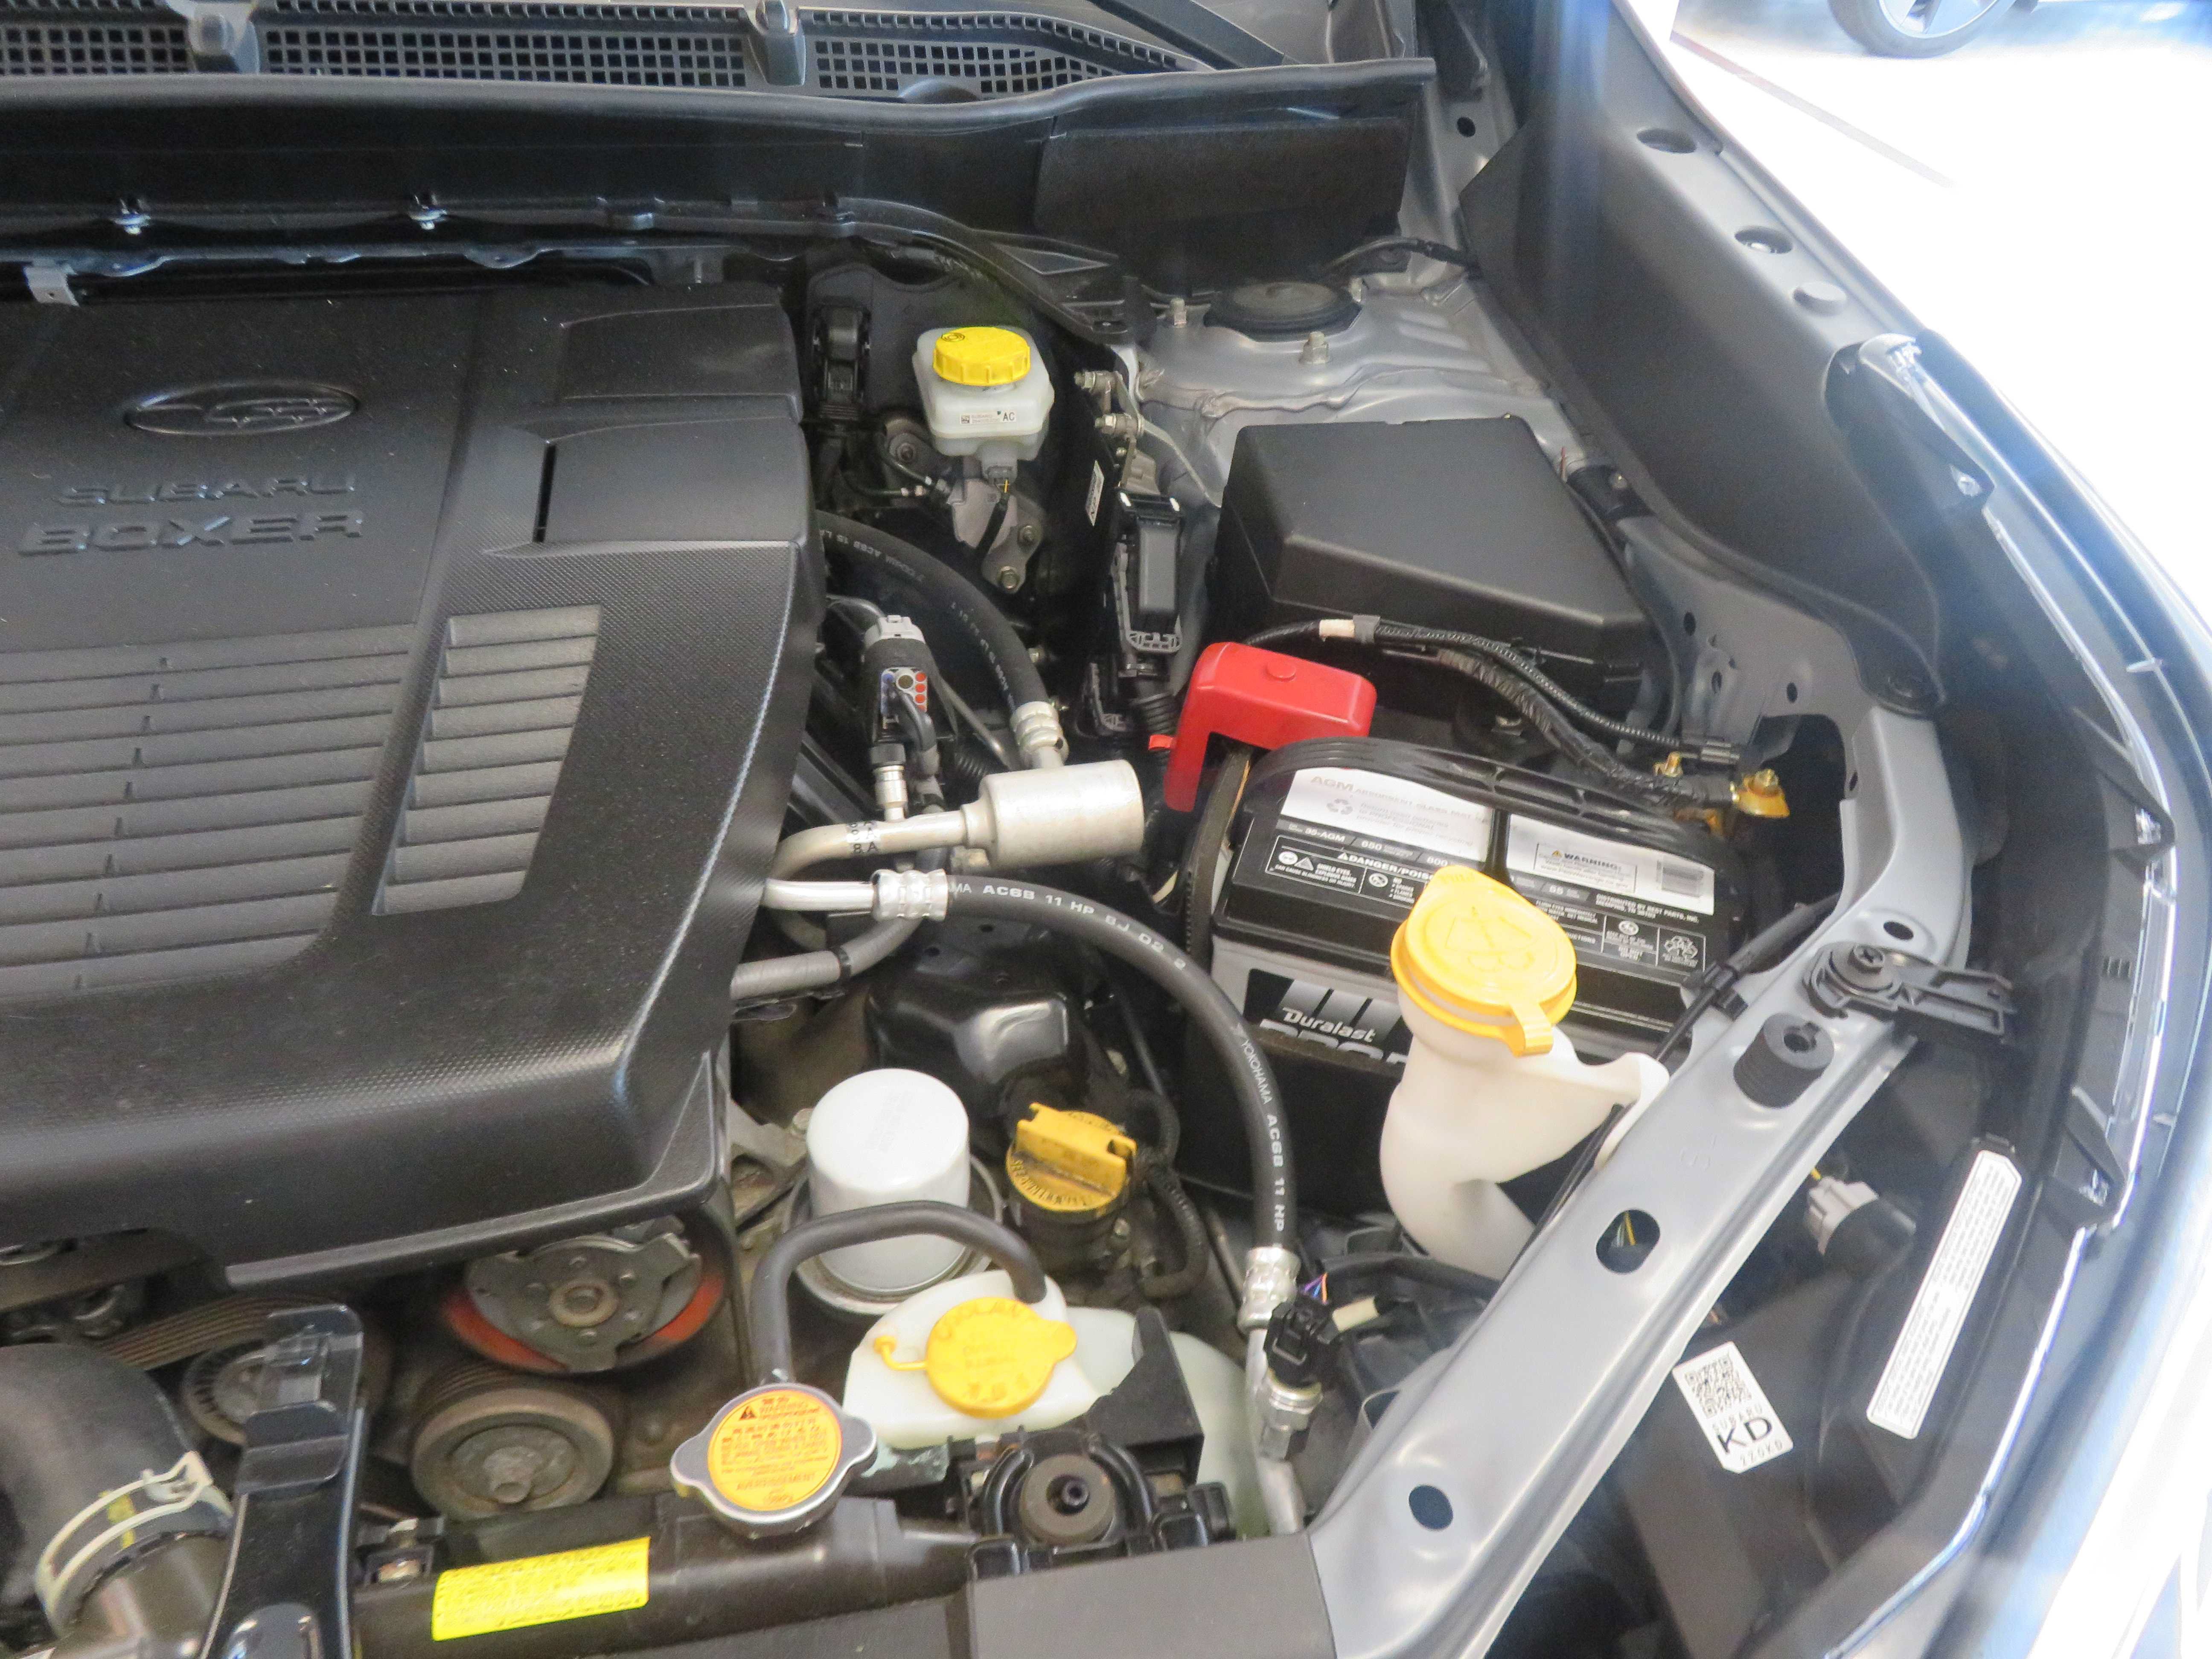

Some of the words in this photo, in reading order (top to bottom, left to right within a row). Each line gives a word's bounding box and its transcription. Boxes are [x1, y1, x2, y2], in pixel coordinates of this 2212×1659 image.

[1003, 411, 1015, 422] AC
[53, 478, 356, 508] SUBARU
[18, 512, 363, 556] BOXER
[1310, 776, 1353, 793] AGM
[982, 884, 1035, 901] AC6B
[1070, 901, 1095, 915] HP
[1282, 1007, 1377, 1043] Duralast
[1240, 1039, 1273, 1105] YOKOHAMA
[1274, 1204, 1285, 1232] HP
[1716, 1415, 1773, 1455] KD
